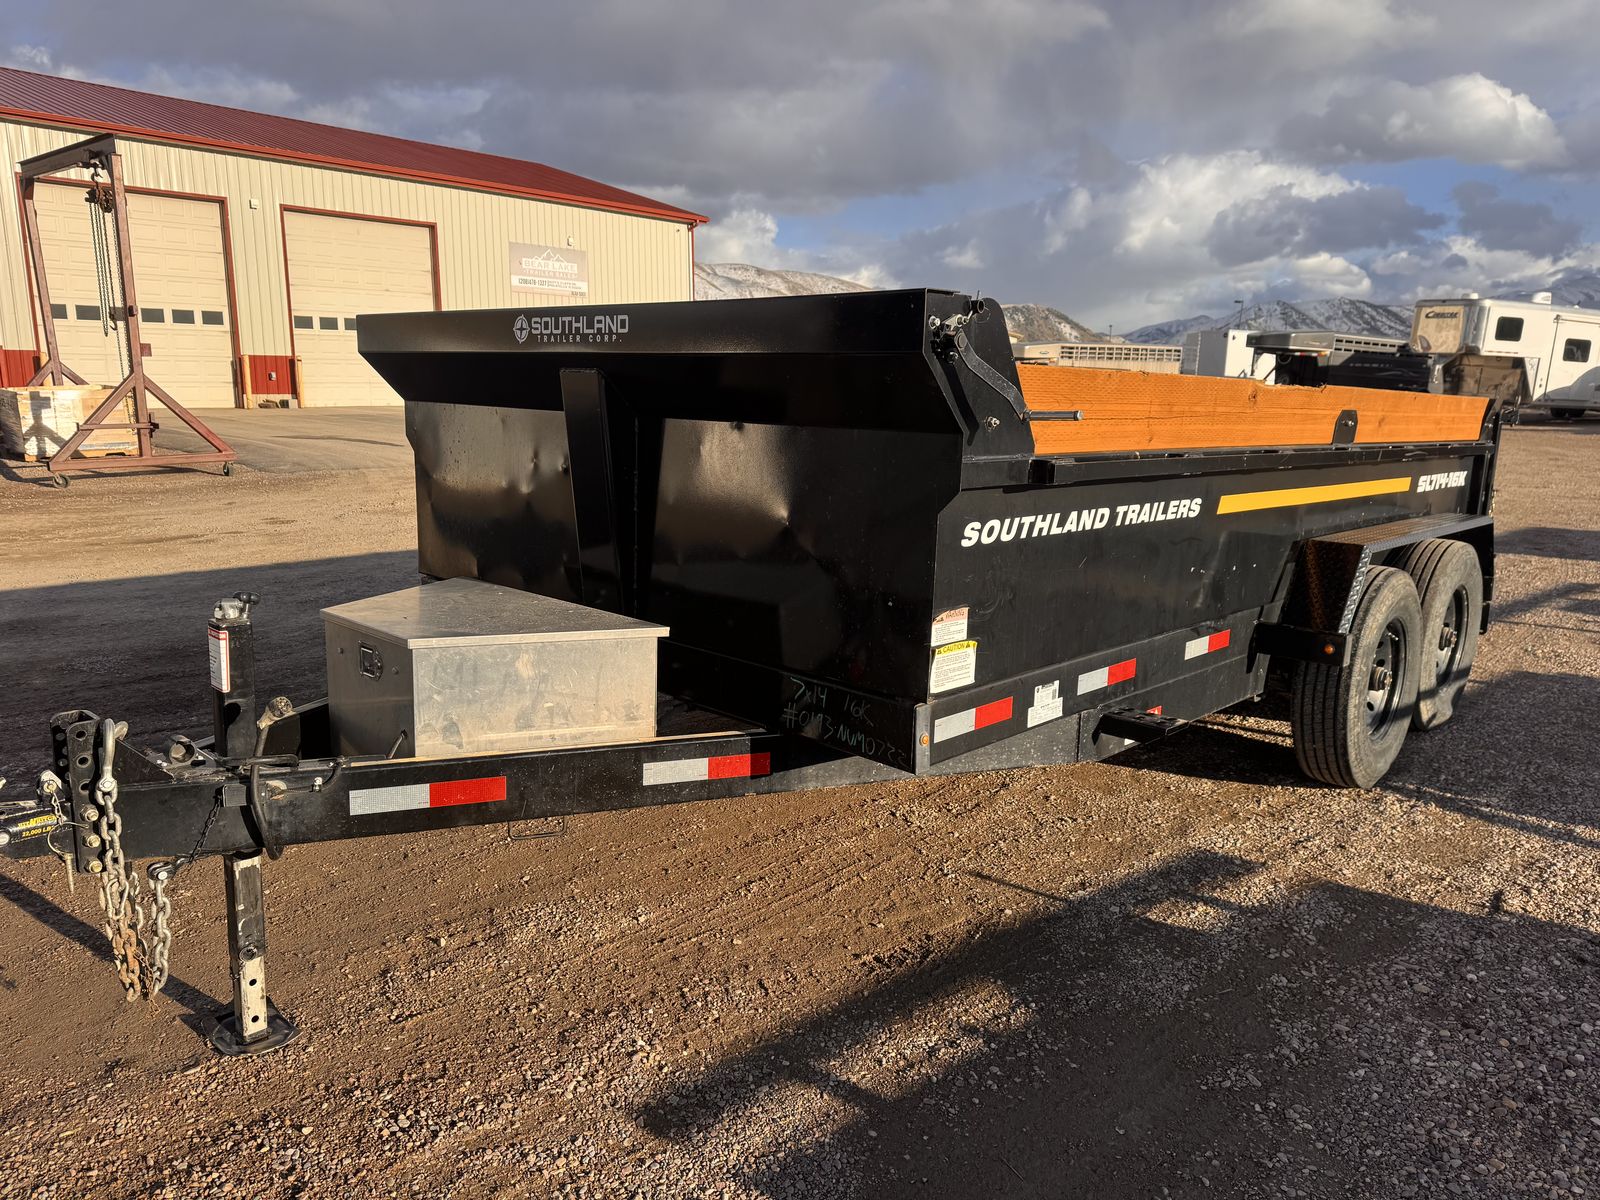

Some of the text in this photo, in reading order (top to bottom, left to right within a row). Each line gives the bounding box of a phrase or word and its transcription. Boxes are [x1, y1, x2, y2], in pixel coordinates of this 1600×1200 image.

[524, 260, 577, 272] BEAR LAKE
[531, 314, 629, 334] SOUTHLAND
[537, 334, 622, 343] TRAILER CORP.
[1416, 470, 1468, 493] SL714-16K
[960, 498, 1202, 547] SOUTHLAND TRAILERS
[943, 642, 966, 653] CAUTION
